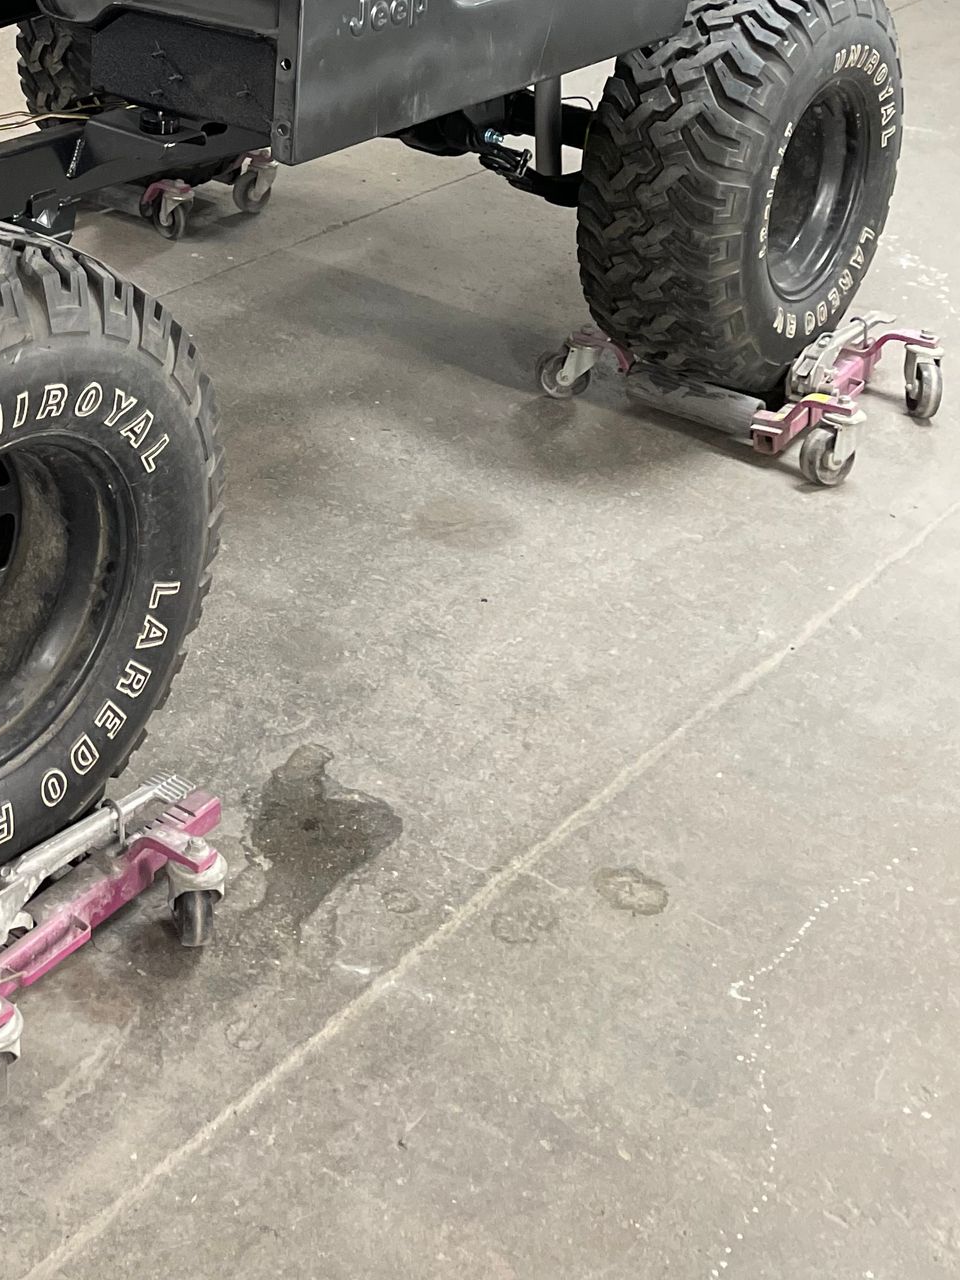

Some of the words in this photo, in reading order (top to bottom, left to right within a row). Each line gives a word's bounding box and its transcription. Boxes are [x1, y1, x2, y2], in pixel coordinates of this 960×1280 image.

[833, 43, 897, 149] UNIROYAL
[772, 306, 797, 339] RV
[804, 226, 876, 336] LAREDO
[40, 579, 182, 809] LAREDO
